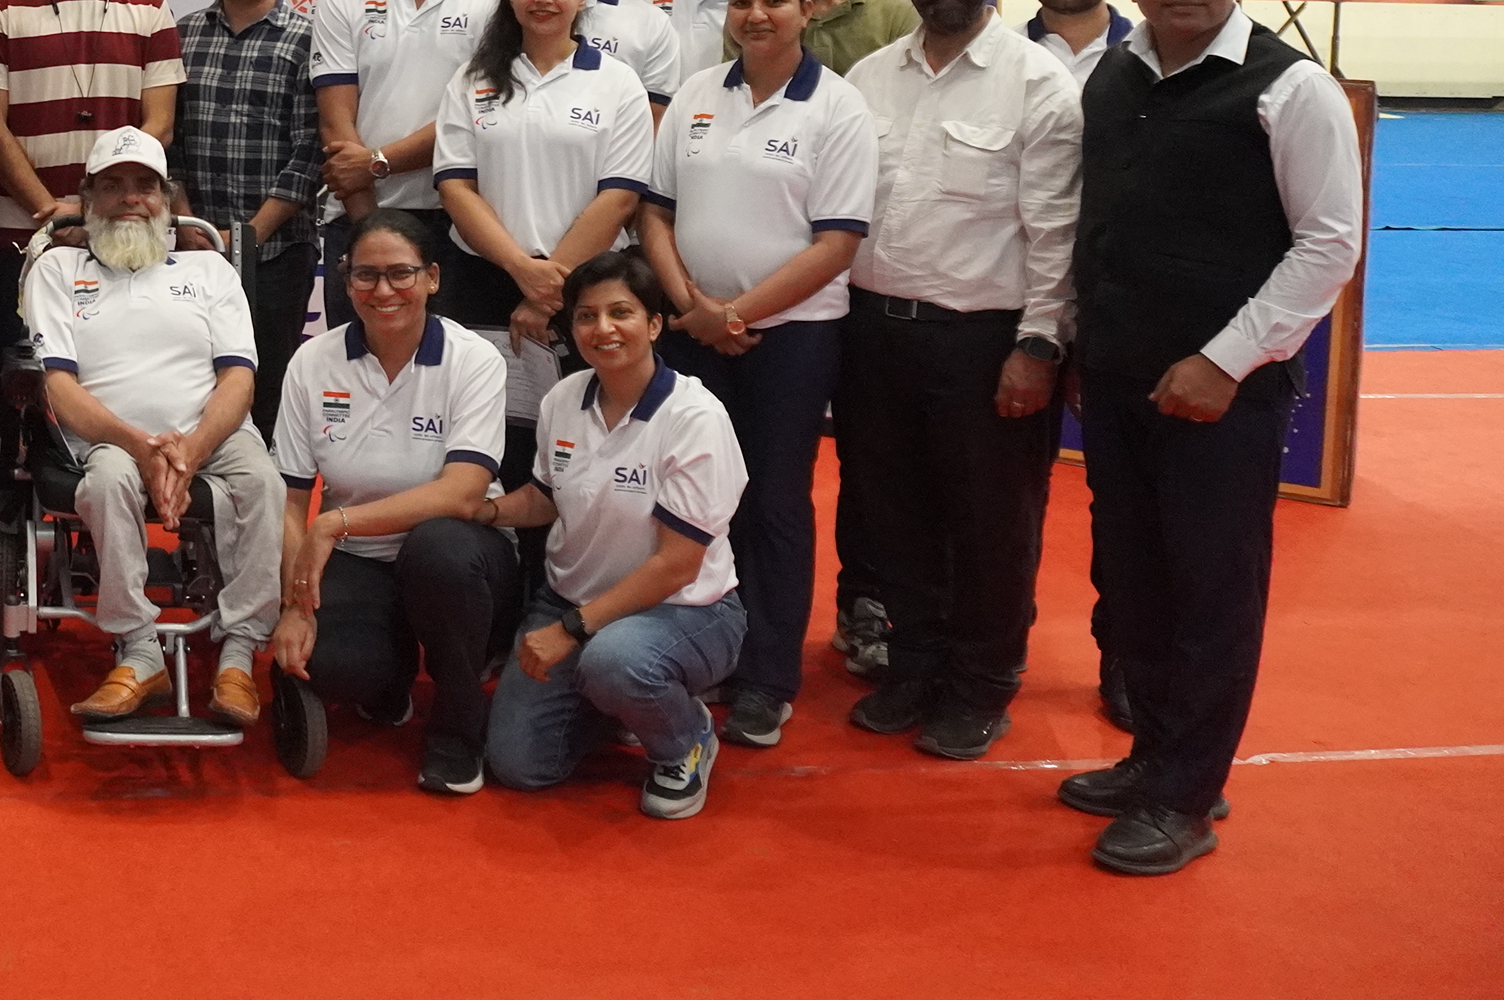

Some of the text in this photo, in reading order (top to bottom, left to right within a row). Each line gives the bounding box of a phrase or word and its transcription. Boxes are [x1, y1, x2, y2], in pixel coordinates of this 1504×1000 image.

[441, 16, 468, 29] SAI
[591, 37, 619, 54] SAI
[570, 107, 600, 125] SAI
[765, 139, 798, 157] SAI
[170, 285, 196, 298] SAI
[411, 417, 443, 434] SAI
[614, 467, 647, 485] SAI
